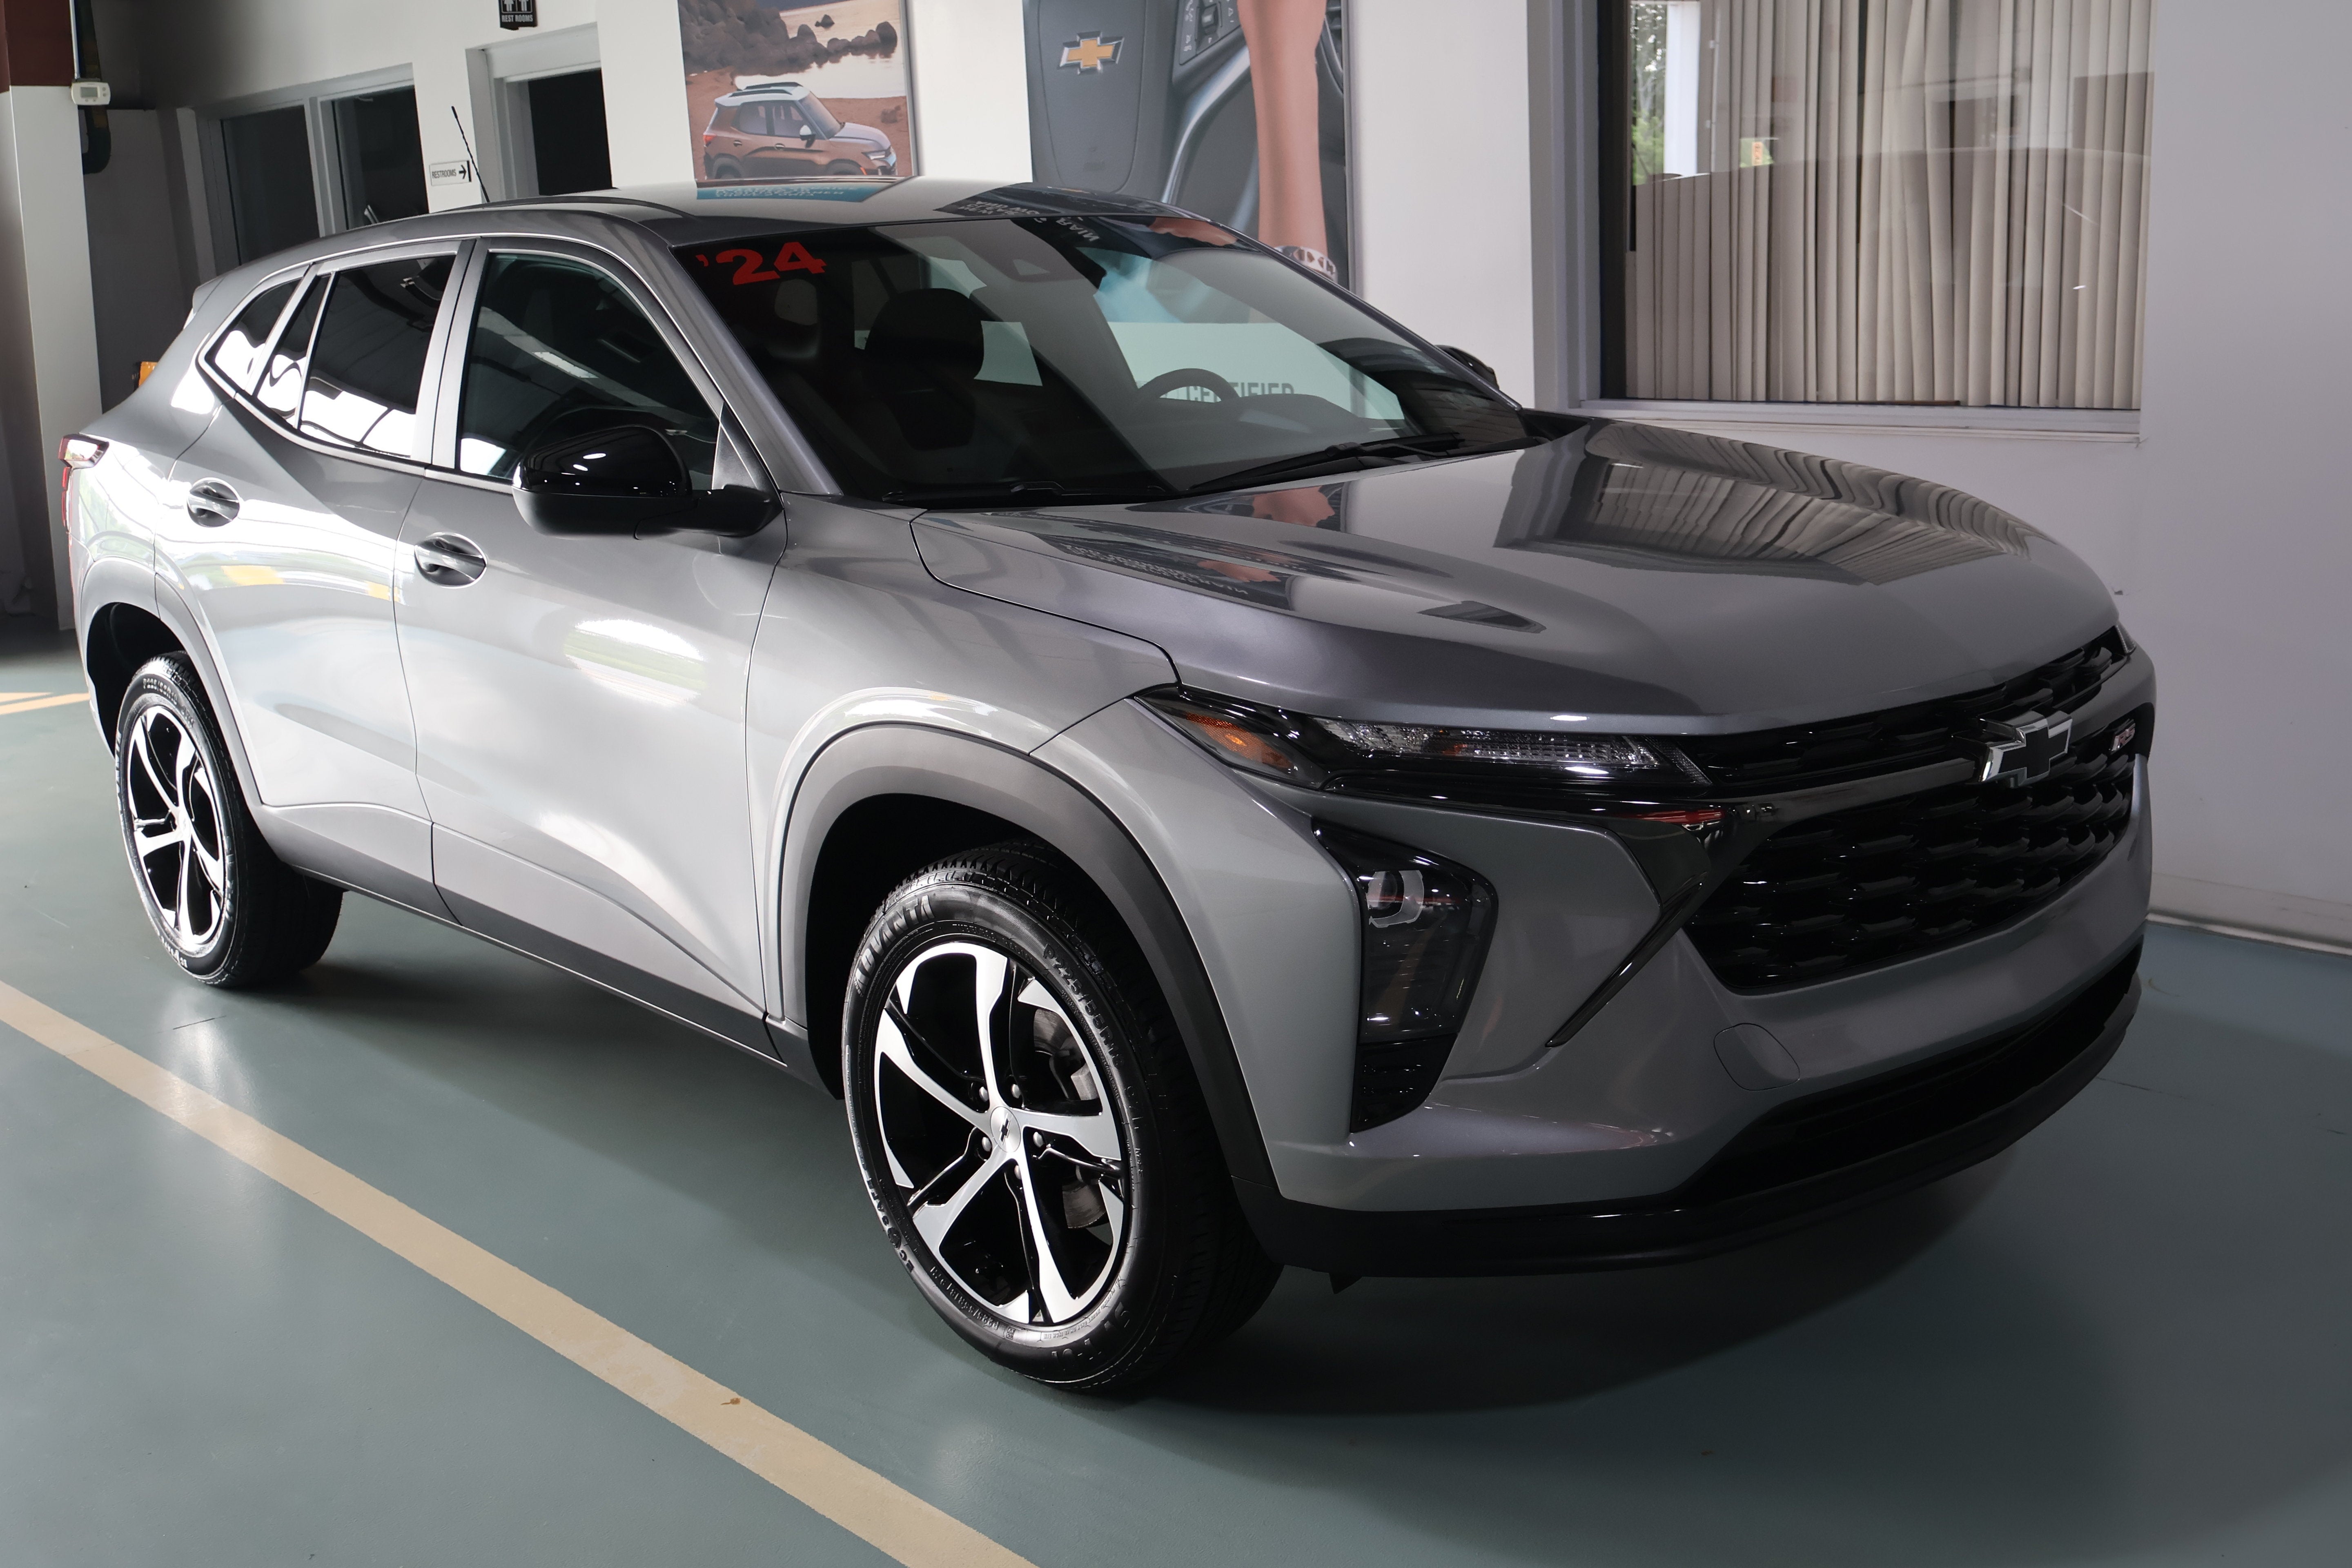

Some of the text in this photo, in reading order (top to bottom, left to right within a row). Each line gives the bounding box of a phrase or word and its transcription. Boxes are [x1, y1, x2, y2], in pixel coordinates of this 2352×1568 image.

[515, 14, 533, 22] ROOMS
[432, 169, 457, 178] RESTROOMS
[855, 894, 935, 995] ADVANTA
